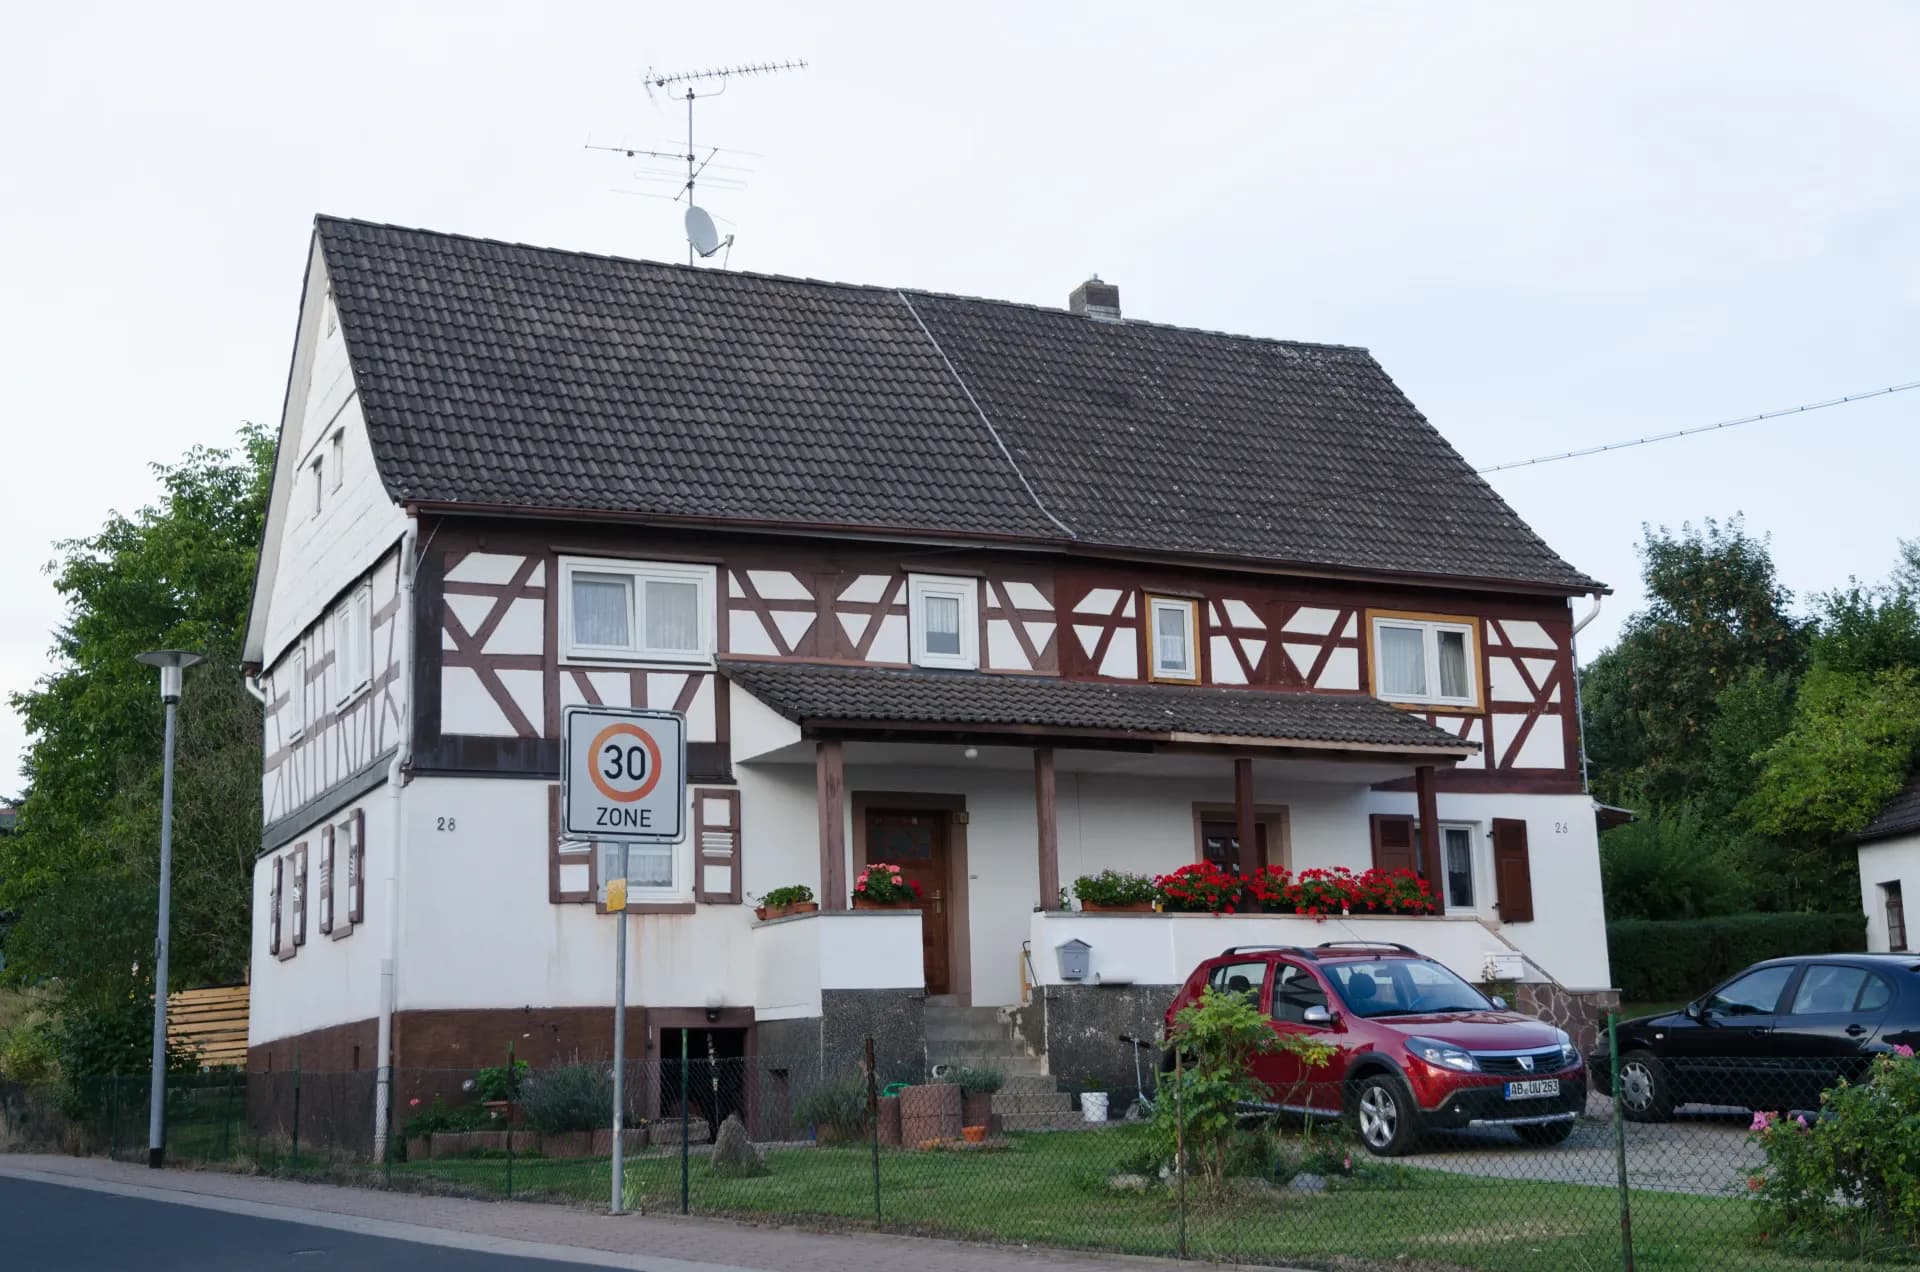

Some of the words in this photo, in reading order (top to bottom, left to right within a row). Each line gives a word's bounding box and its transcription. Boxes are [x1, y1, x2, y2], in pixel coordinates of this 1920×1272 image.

[603, 744, 646, 781] 30
[437, 816, 456, 832] 28
[596, 807, 652, 828] ZONE
[1555, 822, 1568, 834] 26
[1511, 1083, 1523, 1095] AB
